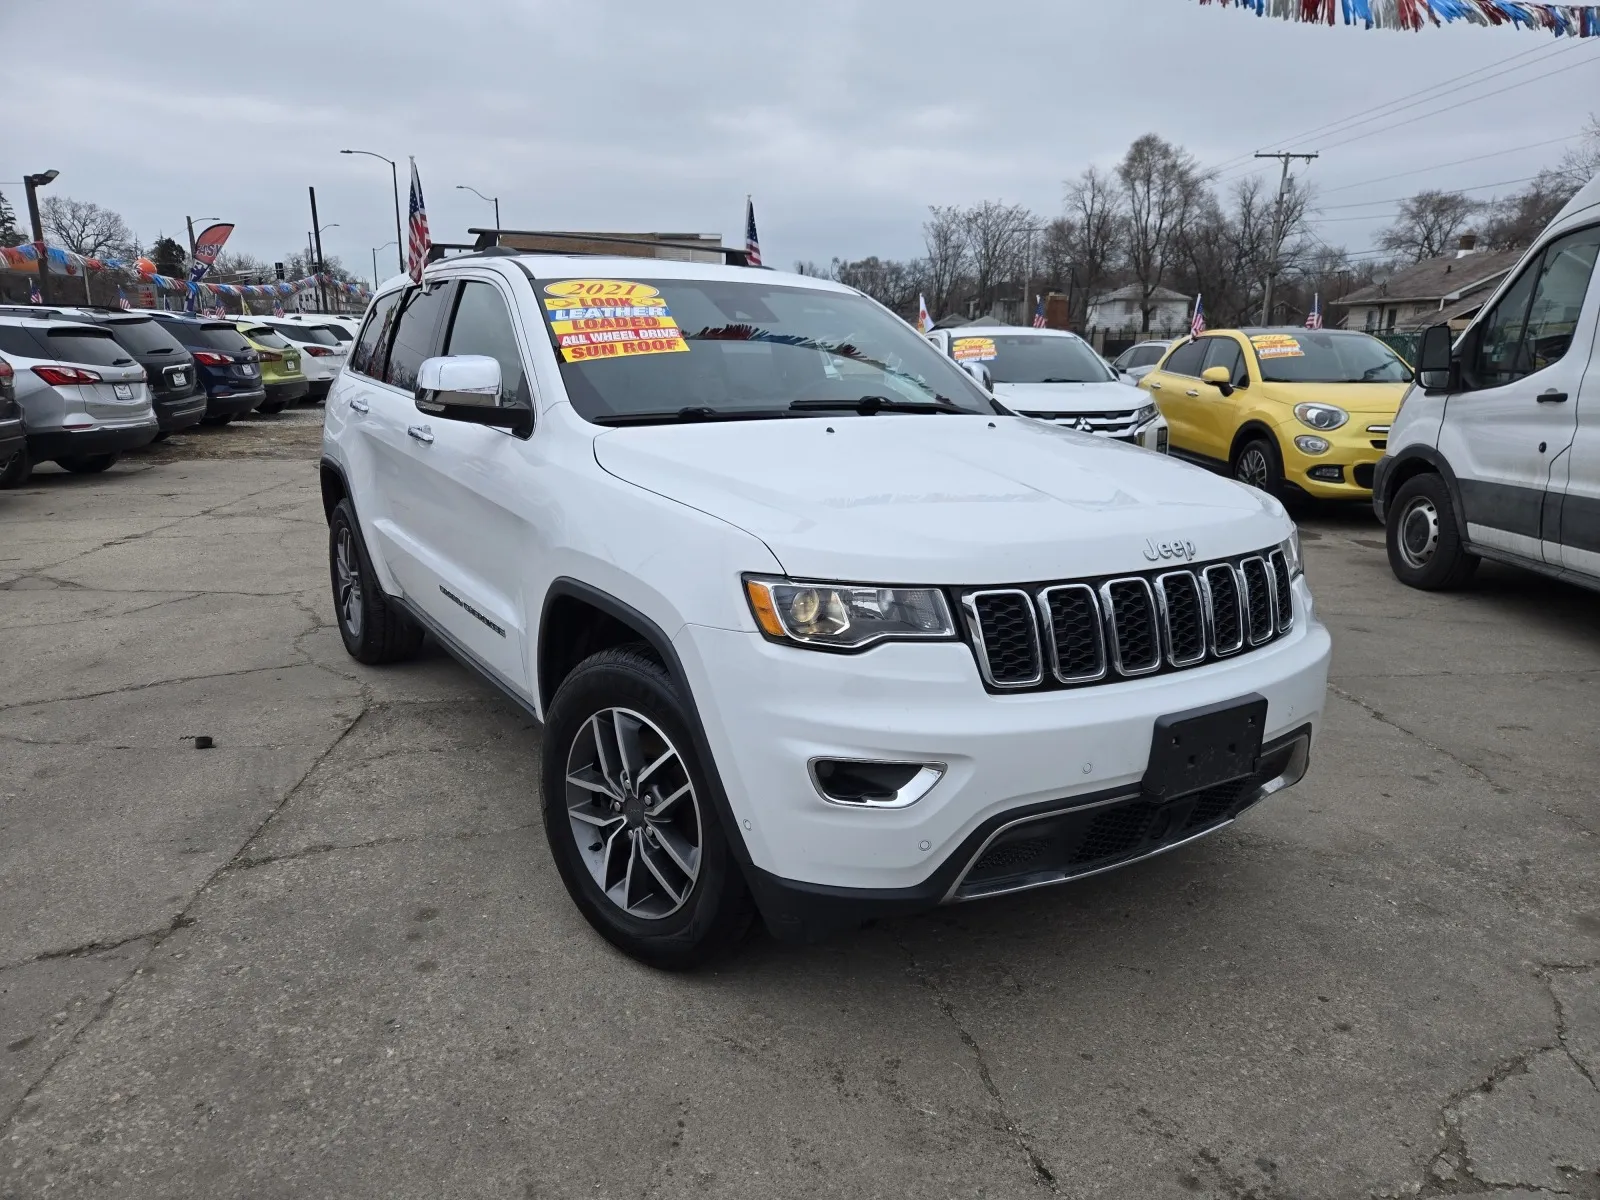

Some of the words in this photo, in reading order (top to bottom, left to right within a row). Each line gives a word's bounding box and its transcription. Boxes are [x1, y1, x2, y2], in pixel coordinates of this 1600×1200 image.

[565, 283, 638, 296] 2021
[578, 297, 635, 308] LOOK
[555, 306, 667, 320] LEATHER
[572, 317, 661, 331] LOADED
[561, 334, 591, 347] ALL
[591, 330, 640, 343] WHEEL
[639, 327, 681, 340] DRIVE
[571, 343, 618, 359] SUN
[622, 339, 681, 354] ROOF
[1142, 538, 1196, 561] Jeep
